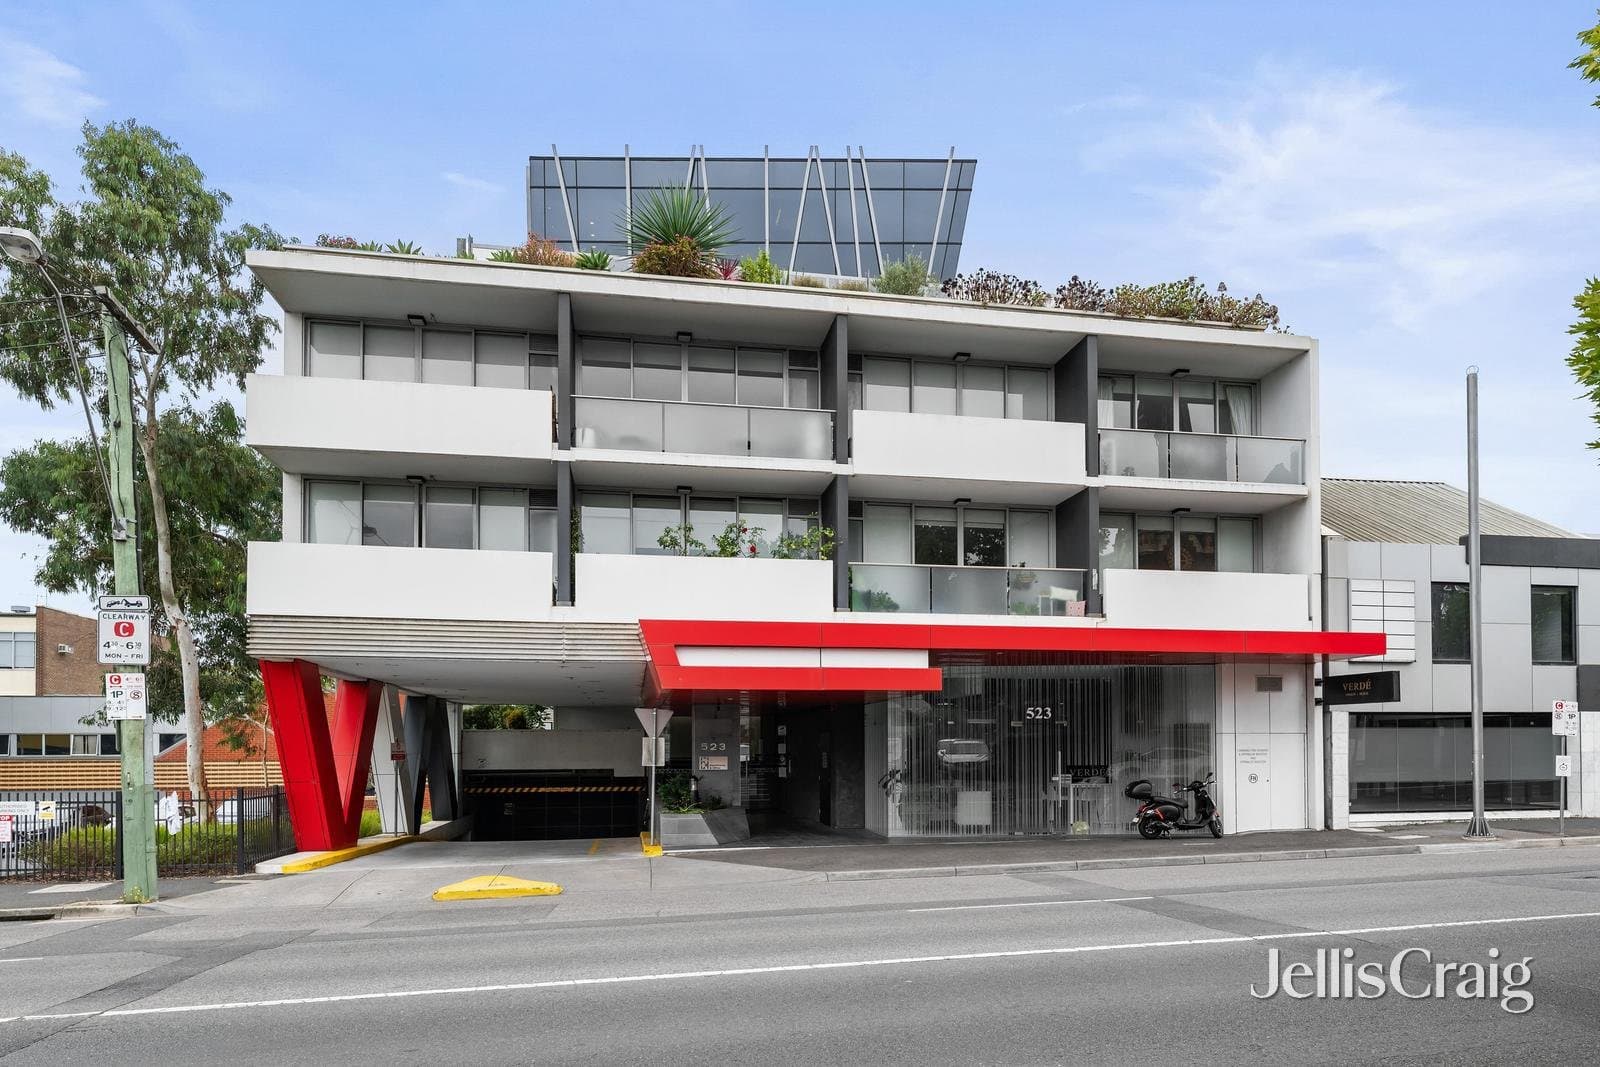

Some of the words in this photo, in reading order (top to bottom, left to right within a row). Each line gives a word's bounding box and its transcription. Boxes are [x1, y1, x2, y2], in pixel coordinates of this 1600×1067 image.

[110, 690, 124, 698] 1P
[1026, 707, 1052, 719] 523
[701, 742, 726, 751] 523
